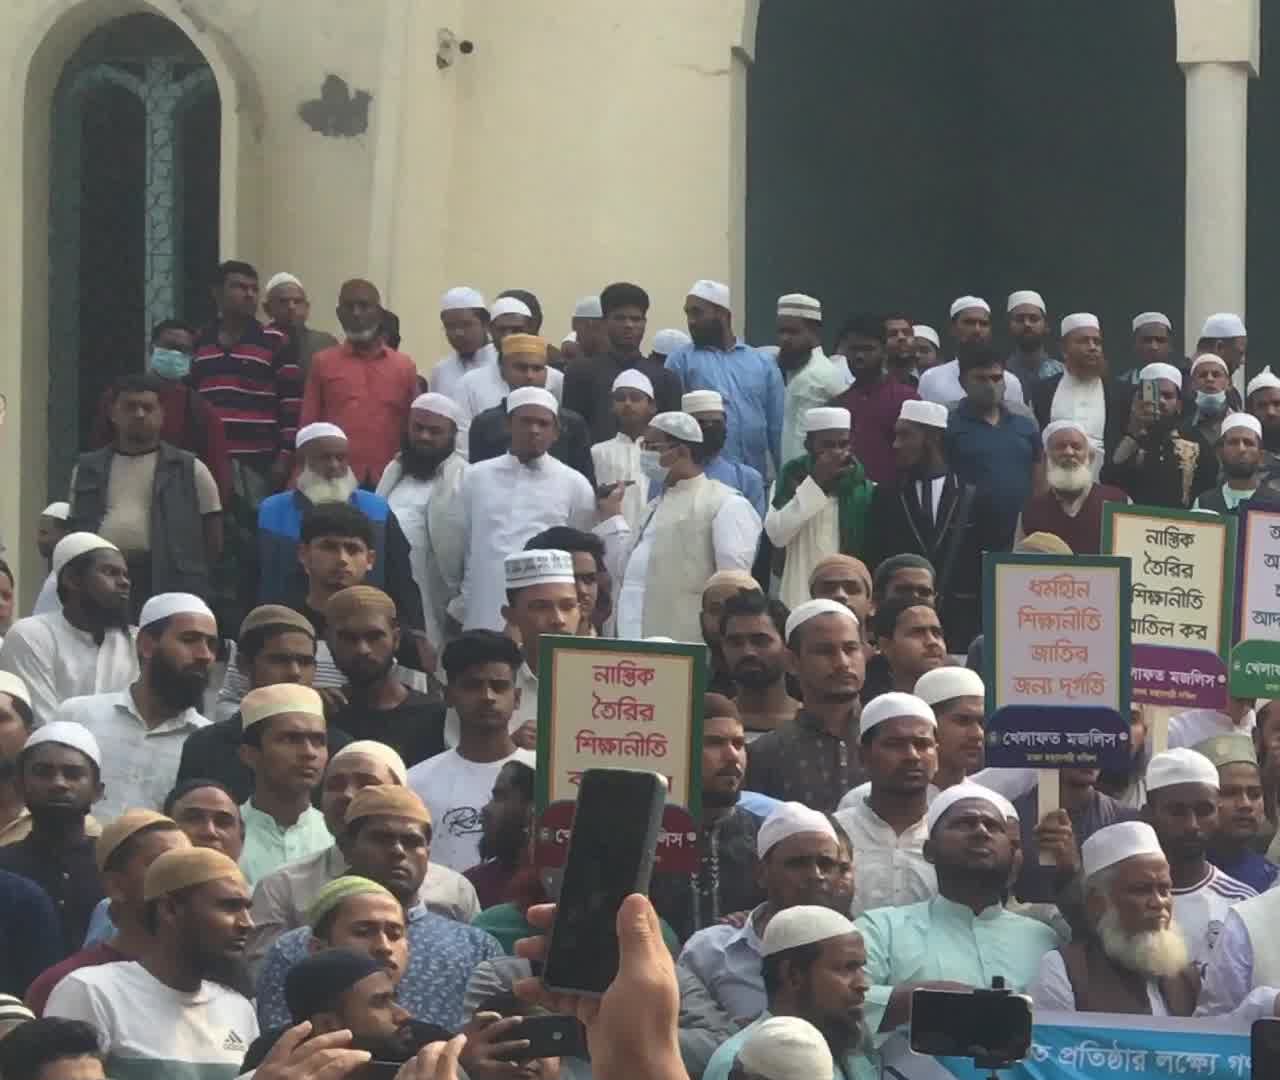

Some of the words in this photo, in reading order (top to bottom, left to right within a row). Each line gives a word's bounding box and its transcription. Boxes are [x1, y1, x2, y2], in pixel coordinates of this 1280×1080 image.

[1146, 525, 1195, 549] নাস্তিক
[1143, 551, 1194, 579] তৈরির
[1018, 606, 1103, 632] শিক্ষানীতি
[1180, 623, 1208, 640] কর
[1031, 640, 1089, 664] জাতির
[592, 660, 655, 687] নাস্তিক
[592, 691, 655, 721] তৈরির
[576, 730, 668, 757] শিক্ষানীতি
[1003, 730, 1060, 746] খেলাফত
[1066, 728, 1116, 749] মজলিস
[1057, 1040, 1148, 1073] প্রতিষ্ঠার
[1155, 1050, 1221, 1076] লক্ষ্যে
